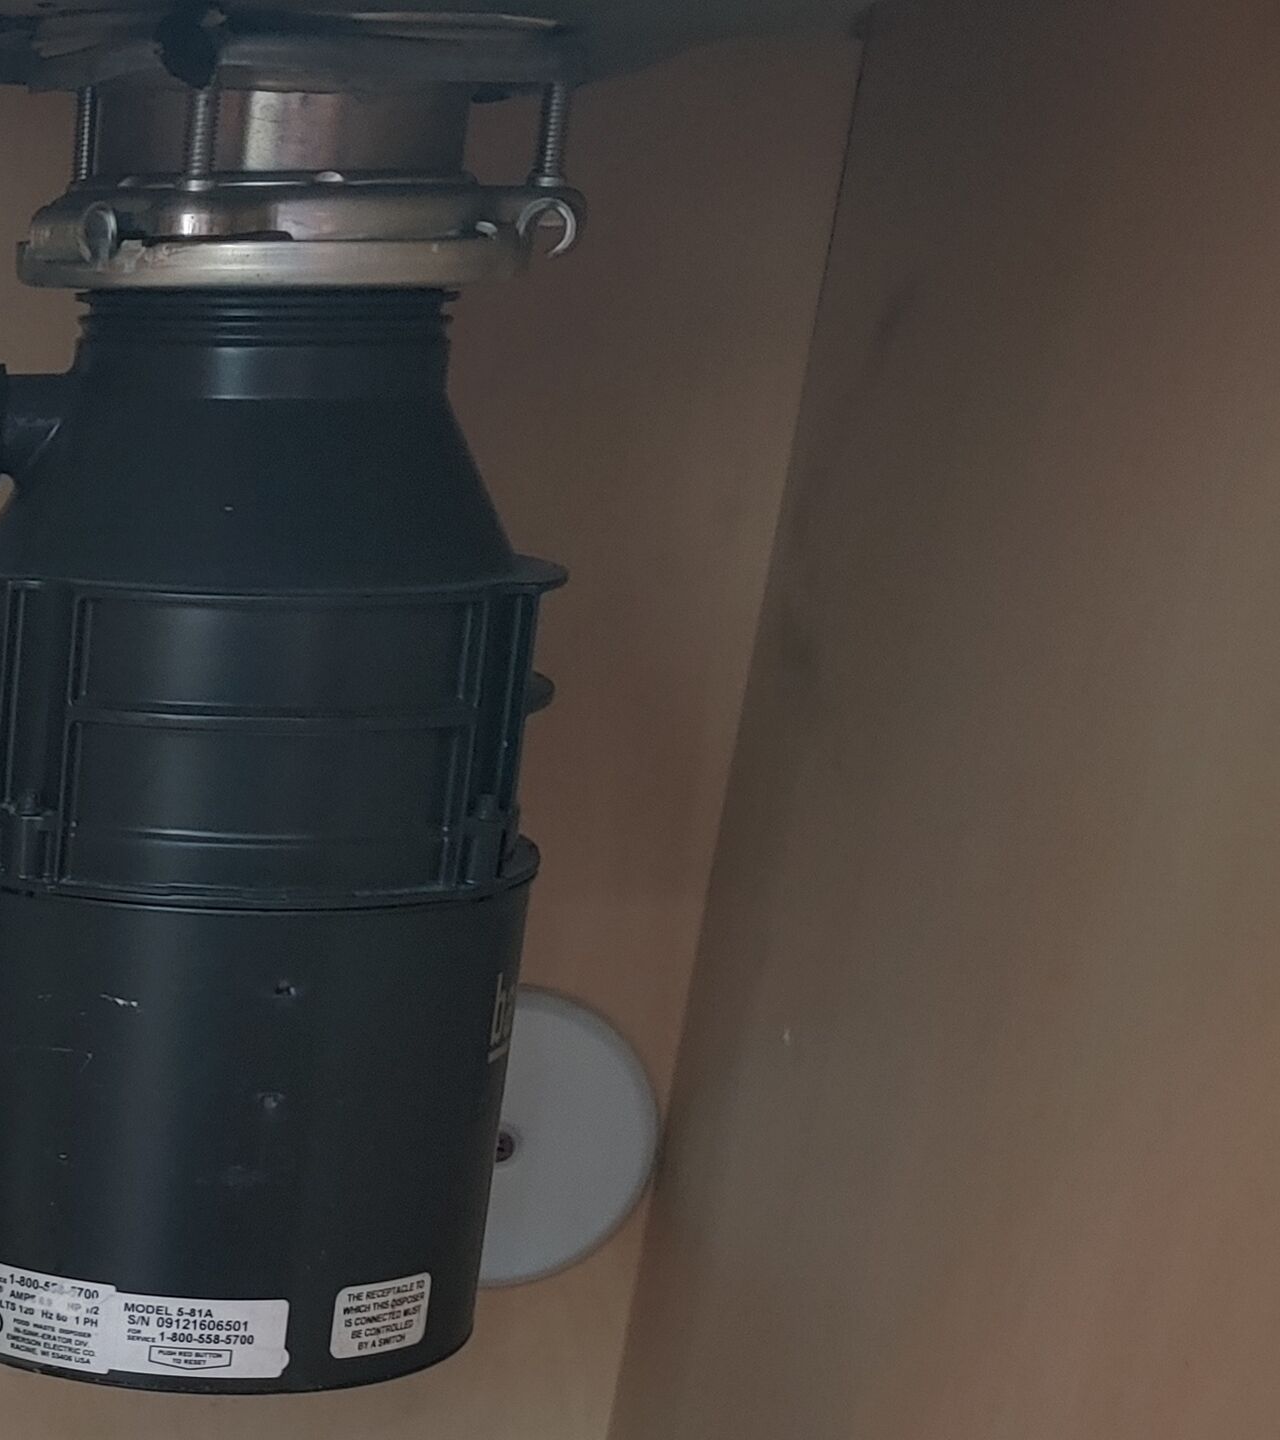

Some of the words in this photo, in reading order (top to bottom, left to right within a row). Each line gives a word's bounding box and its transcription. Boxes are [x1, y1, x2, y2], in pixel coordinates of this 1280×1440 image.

[347, 1292, 363, 1302] THE
[366, 1282, 414, 1300] RECEPTACLE
[123, 1302, 172, 1316] MODEL
[176, 1307, 213, 1319] 5-81A
[343, 1303, 371, 1315] WHICH
[354, 1309, 401, 1326] CONNECTED
[127, 1314, 150, 1327] S/N
[156, 1317, 249, 1332] 09121606501
[364, 1319, 413, 1337] CONTROLLED
[127, 1334, 156, 1344] SERVICE
[159, 1331, 255, 1346] 1-800-558-5700
